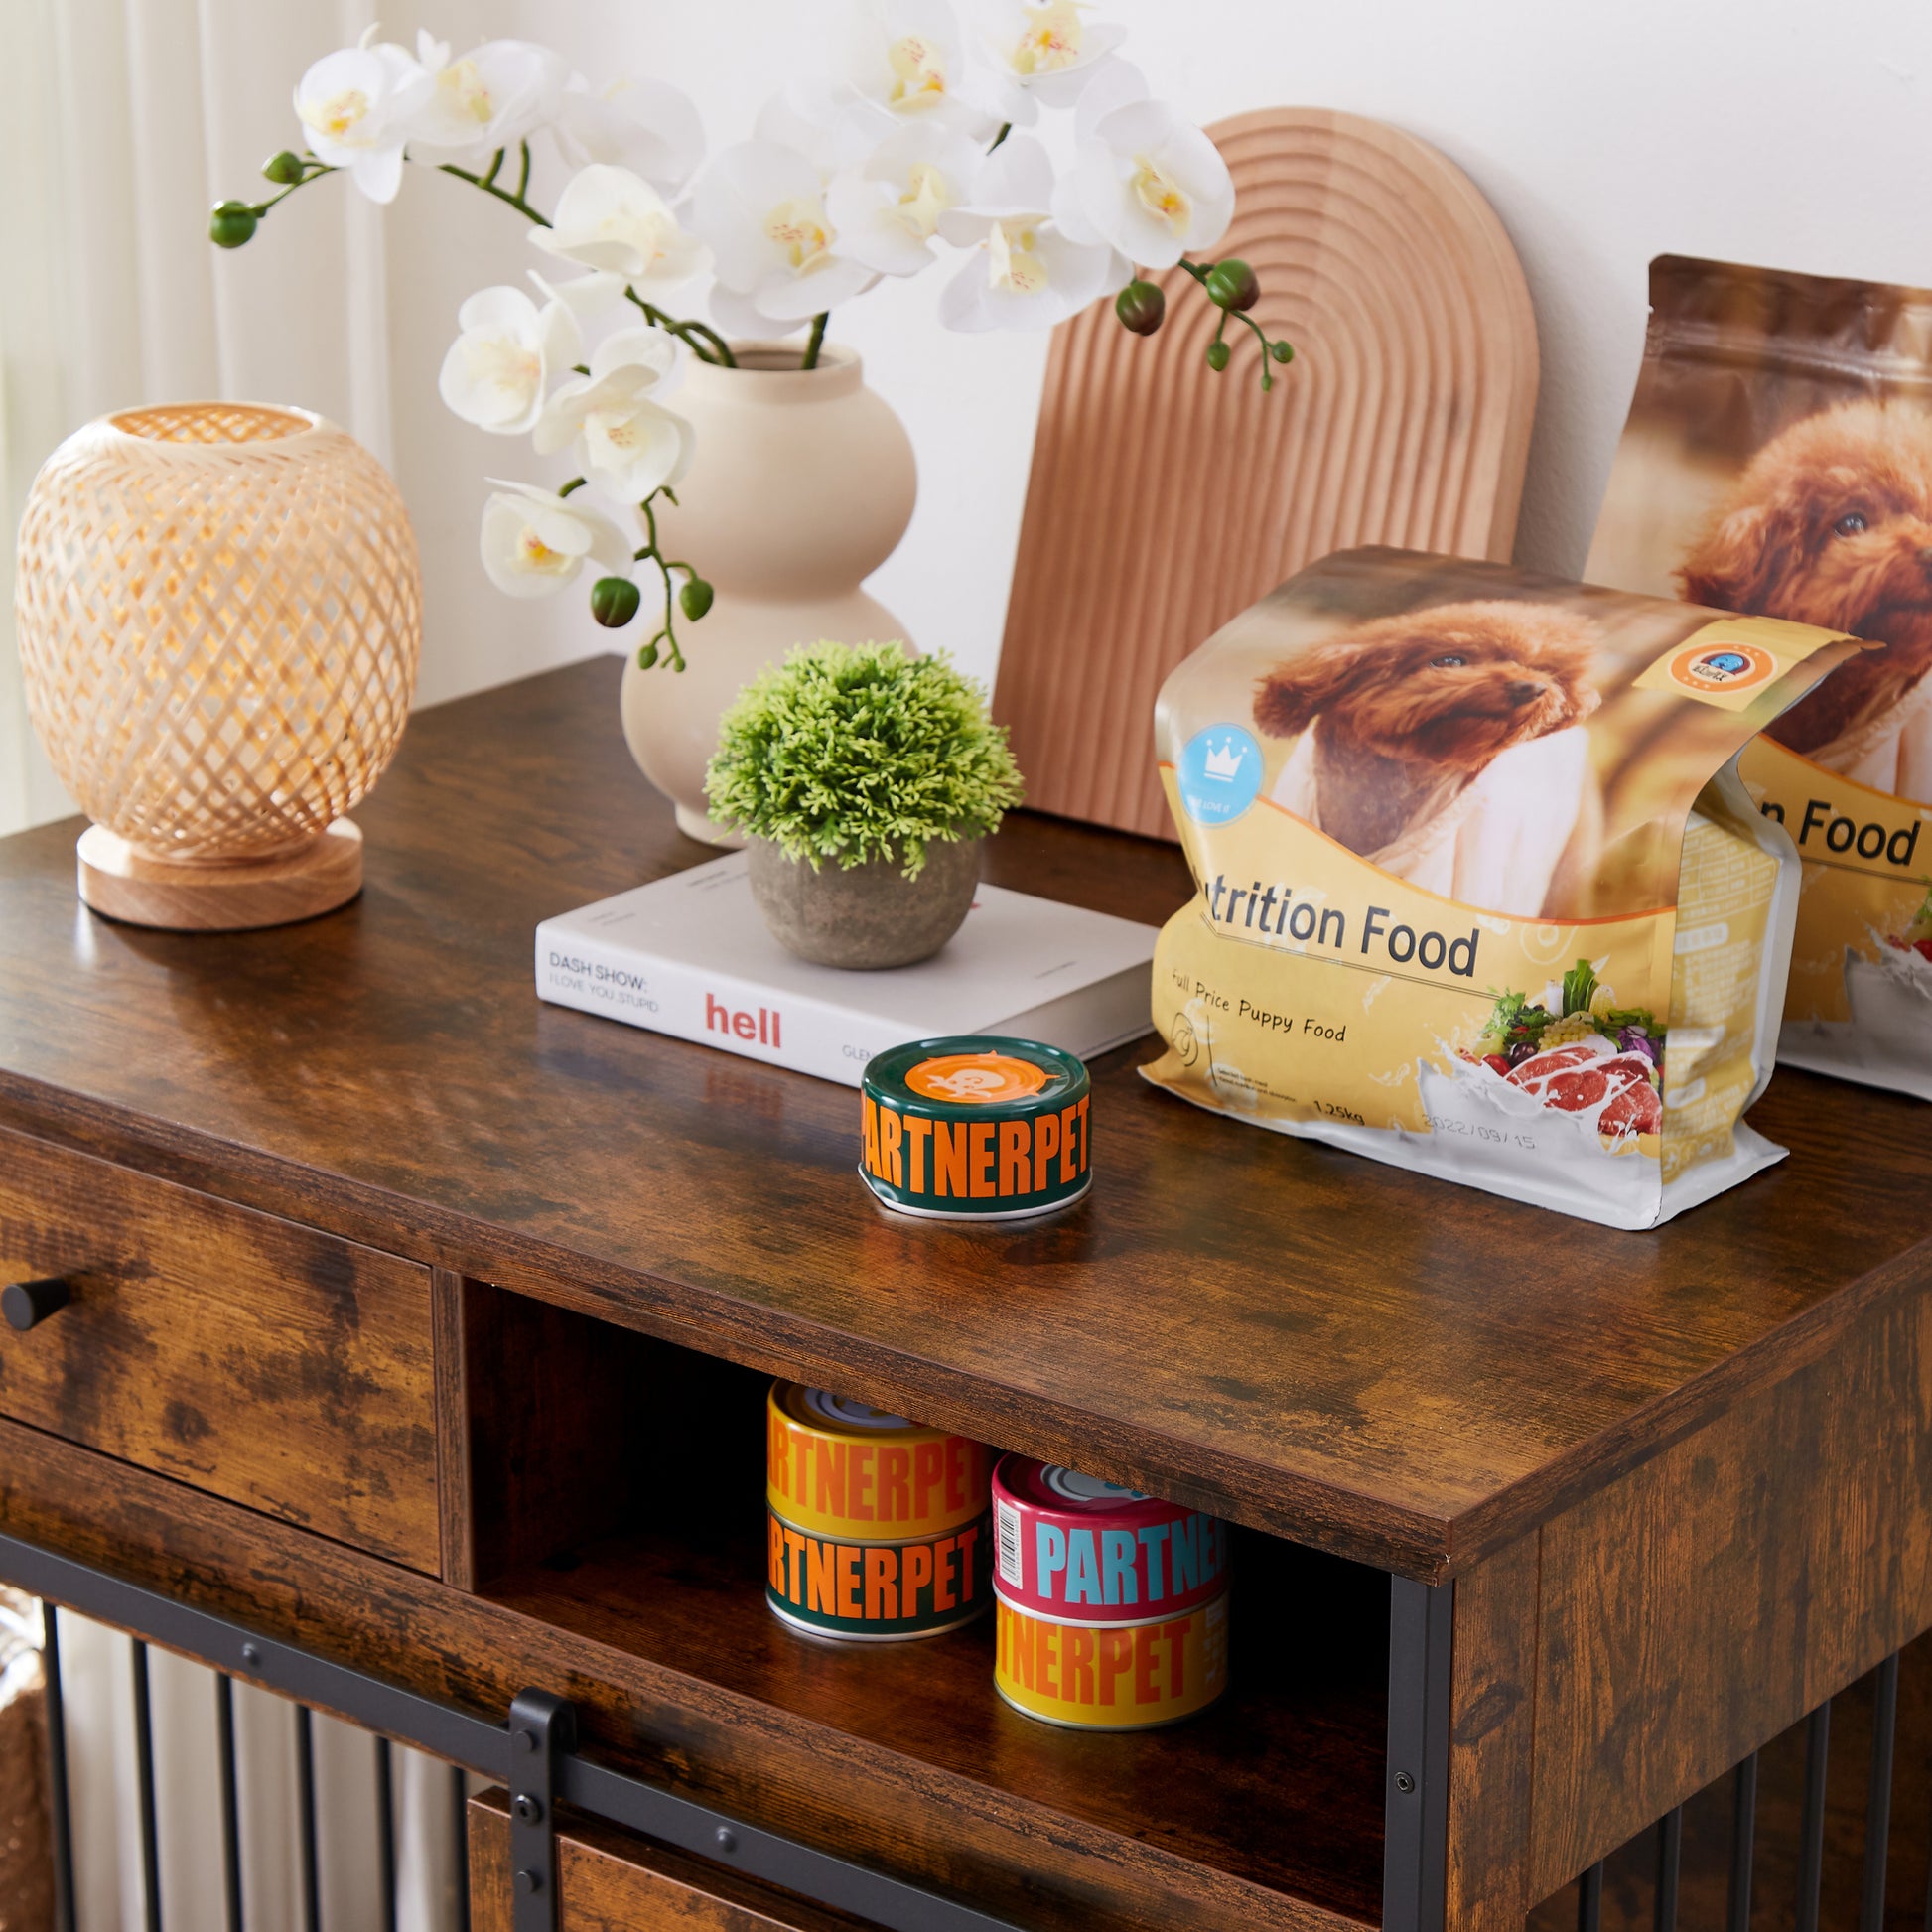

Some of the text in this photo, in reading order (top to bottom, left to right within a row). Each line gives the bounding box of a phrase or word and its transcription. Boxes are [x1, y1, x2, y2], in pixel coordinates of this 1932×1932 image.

[1798, 799, 1921, 866] Food
[549, 952, 592, 976] DASH
[1360, 905, 1480, 978] Food
[706, 993, 781, 1048] hell
[1195, 981, 1230, 1011] Price
[1238, 999, 1293, 1034] Puppy
[1303, 1018, 1347, 1042] Food
[1313, 1100, 1365, 1126] 1.25kg
[768, 1510, 978, 1620] RTNERPET
